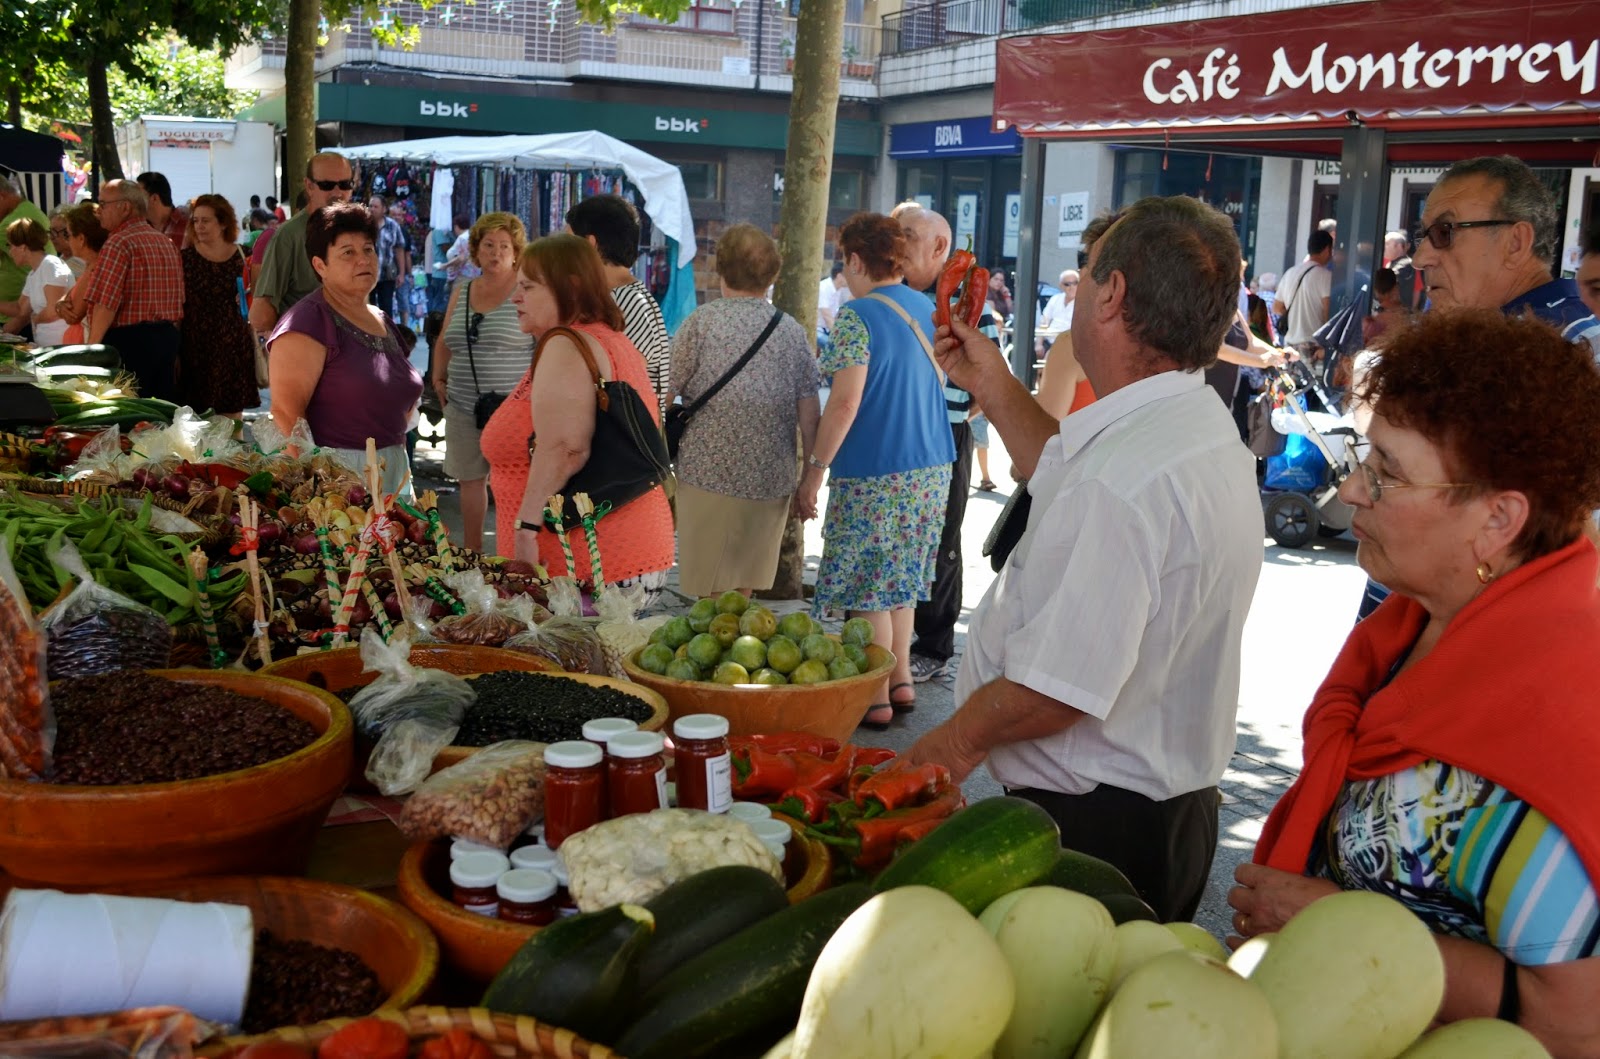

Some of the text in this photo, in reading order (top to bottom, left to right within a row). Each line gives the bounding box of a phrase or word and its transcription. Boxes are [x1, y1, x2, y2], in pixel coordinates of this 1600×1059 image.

[1142, 39, 1598, 104] Café Monterrey
[420, 100, 468, 117] bbk
[655, 116, 699, 132] bbk
[158, 131, 224, 139] JUGUETES
[935, 125, 962, 146] BBVA
[1063, 204, 1083, 221] LIBRE
